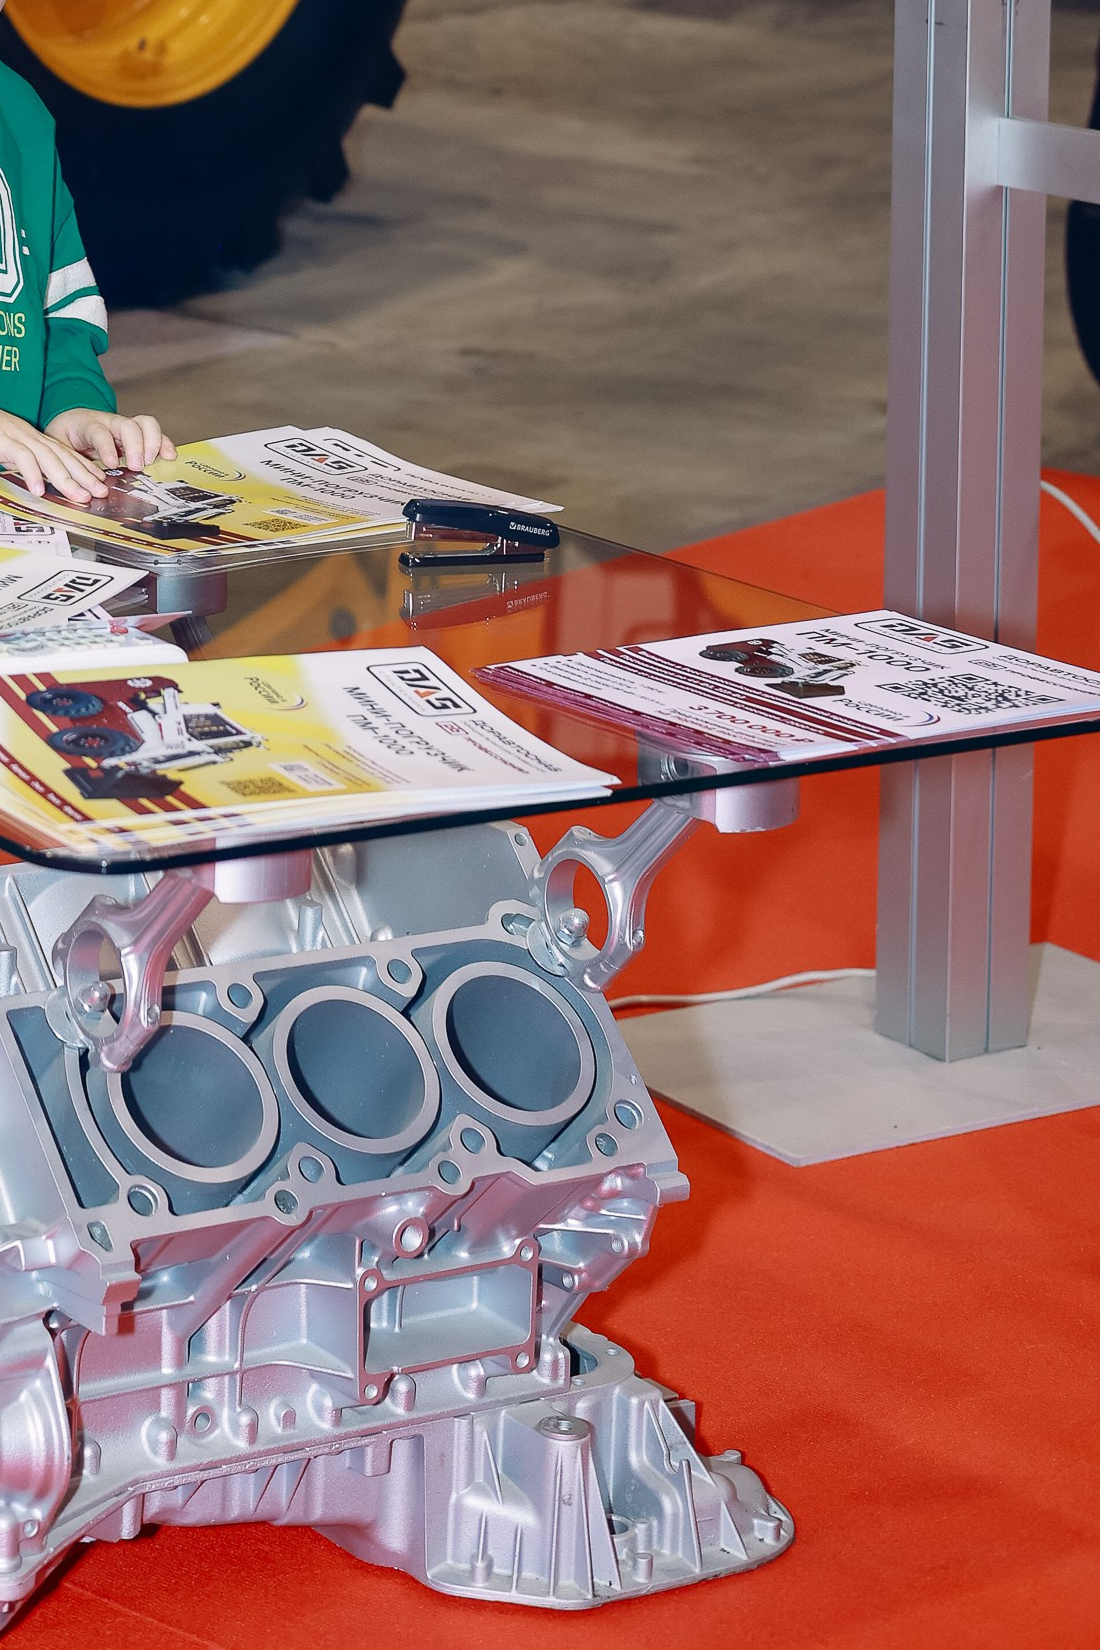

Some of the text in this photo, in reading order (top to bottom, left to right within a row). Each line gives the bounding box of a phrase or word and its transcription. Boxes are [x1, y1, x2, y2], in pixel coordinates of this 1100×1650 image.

[795, 630, 932, 672] ПМ-1000
[346, 713, 414, 756] ПМ-1000
[704, 709, 750, 725] 700
[746, 724, 795, 738] 000
